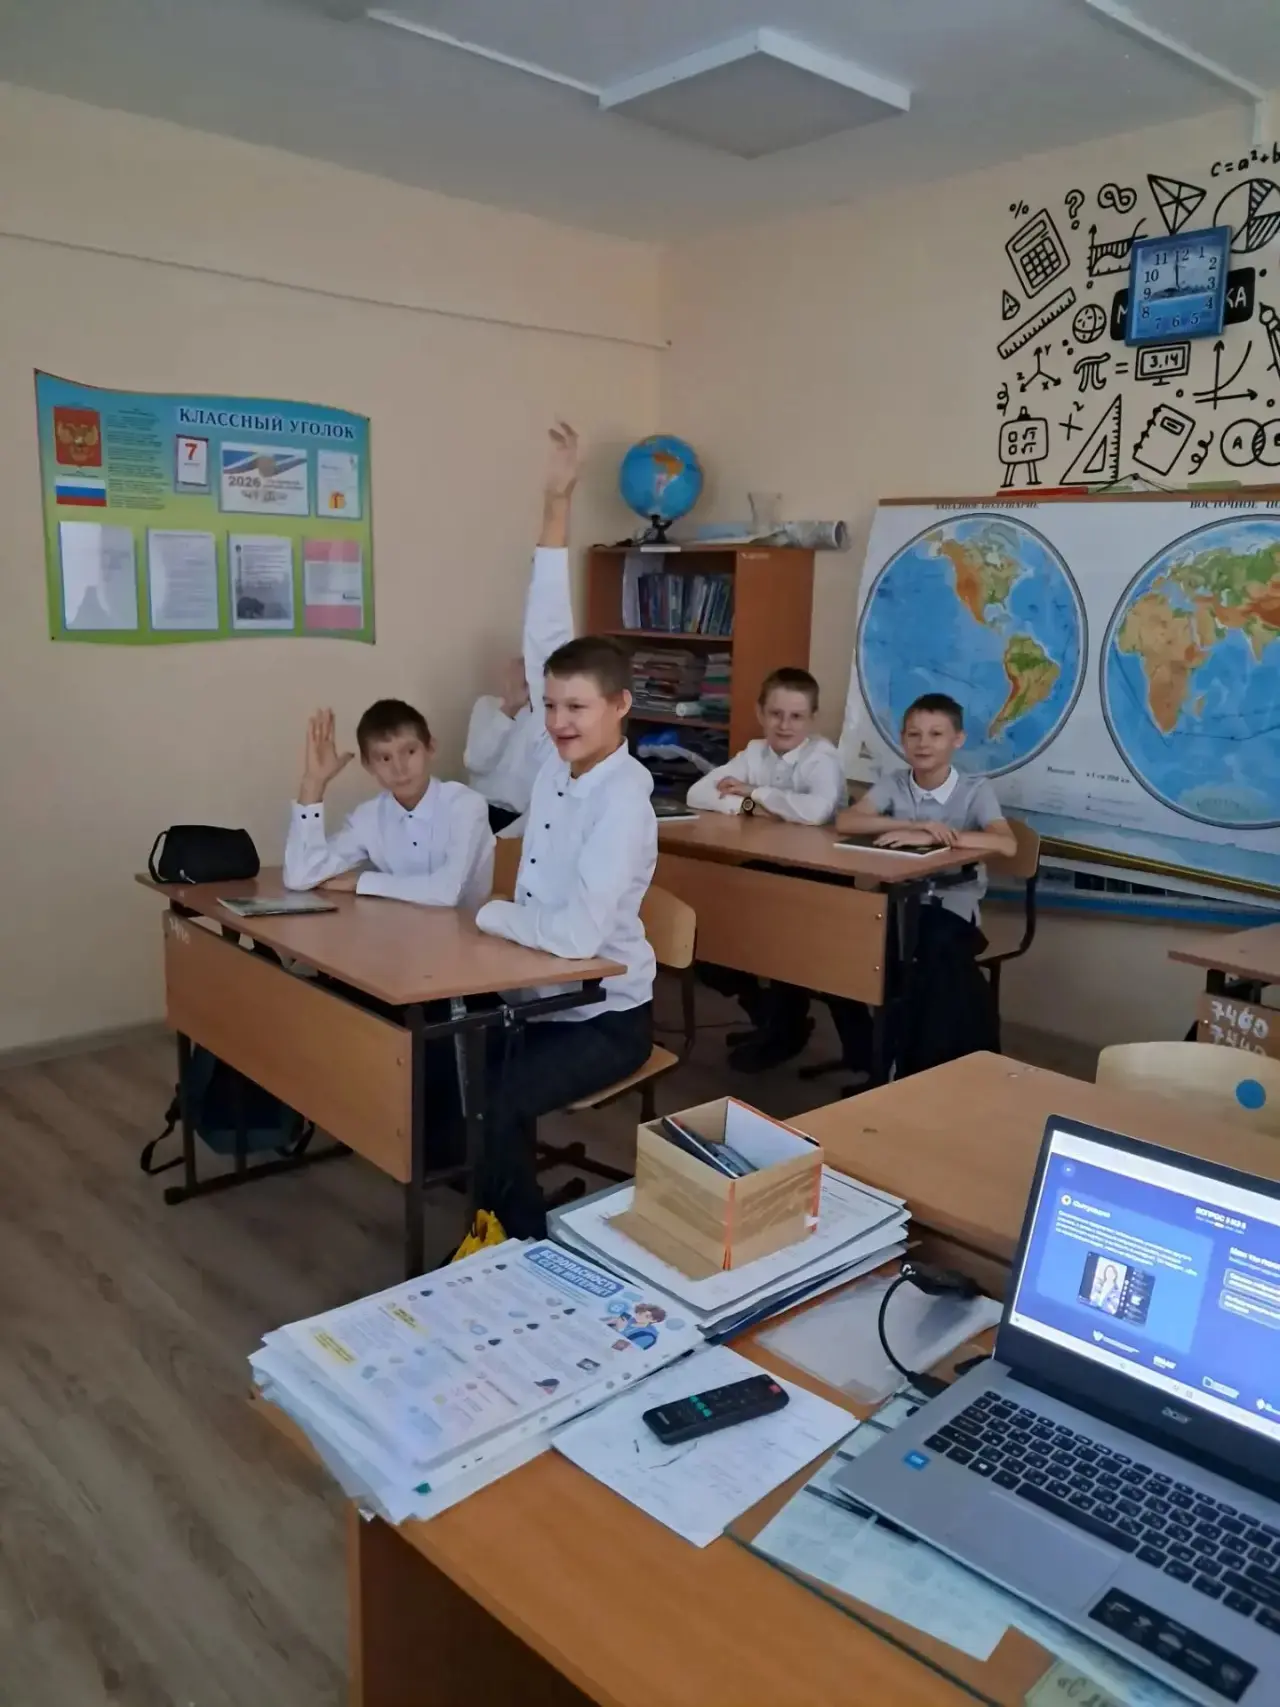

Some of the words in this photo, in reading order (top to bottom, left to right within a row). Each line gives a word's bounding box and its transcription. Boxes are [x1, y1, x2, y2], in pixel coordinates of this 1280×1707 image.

[1154, 252, 1168, 266] 11
[1197, 246, 1206, 259] 1
[1208, 257, 1217, 270] 2
[1144, 269, 1159, 284] 10
[1207, 276, 1216, 290] 3
[1143, 287, 1152, 300] 9
[1204, 297, 1214, 310] 4
[1141, 306, 1150, 319] 8
[1190, 313, 1200, 325] 5
[1154, 318, 1162, 330] 7
[1171, 315, 1181, 328] 6
[179, 408, 283, 432] КЛАССНЫЙ
[289, 420, 355, 439] УГОЛОК
[184, 443, 198, 461] 7
[228, 475, 262, 488] 2026
[539, 1249, 618, 1291] БЕЗОПАСНОСТЬ
[561, 1270, 614, 1297] ИНТЕРНЕТ
